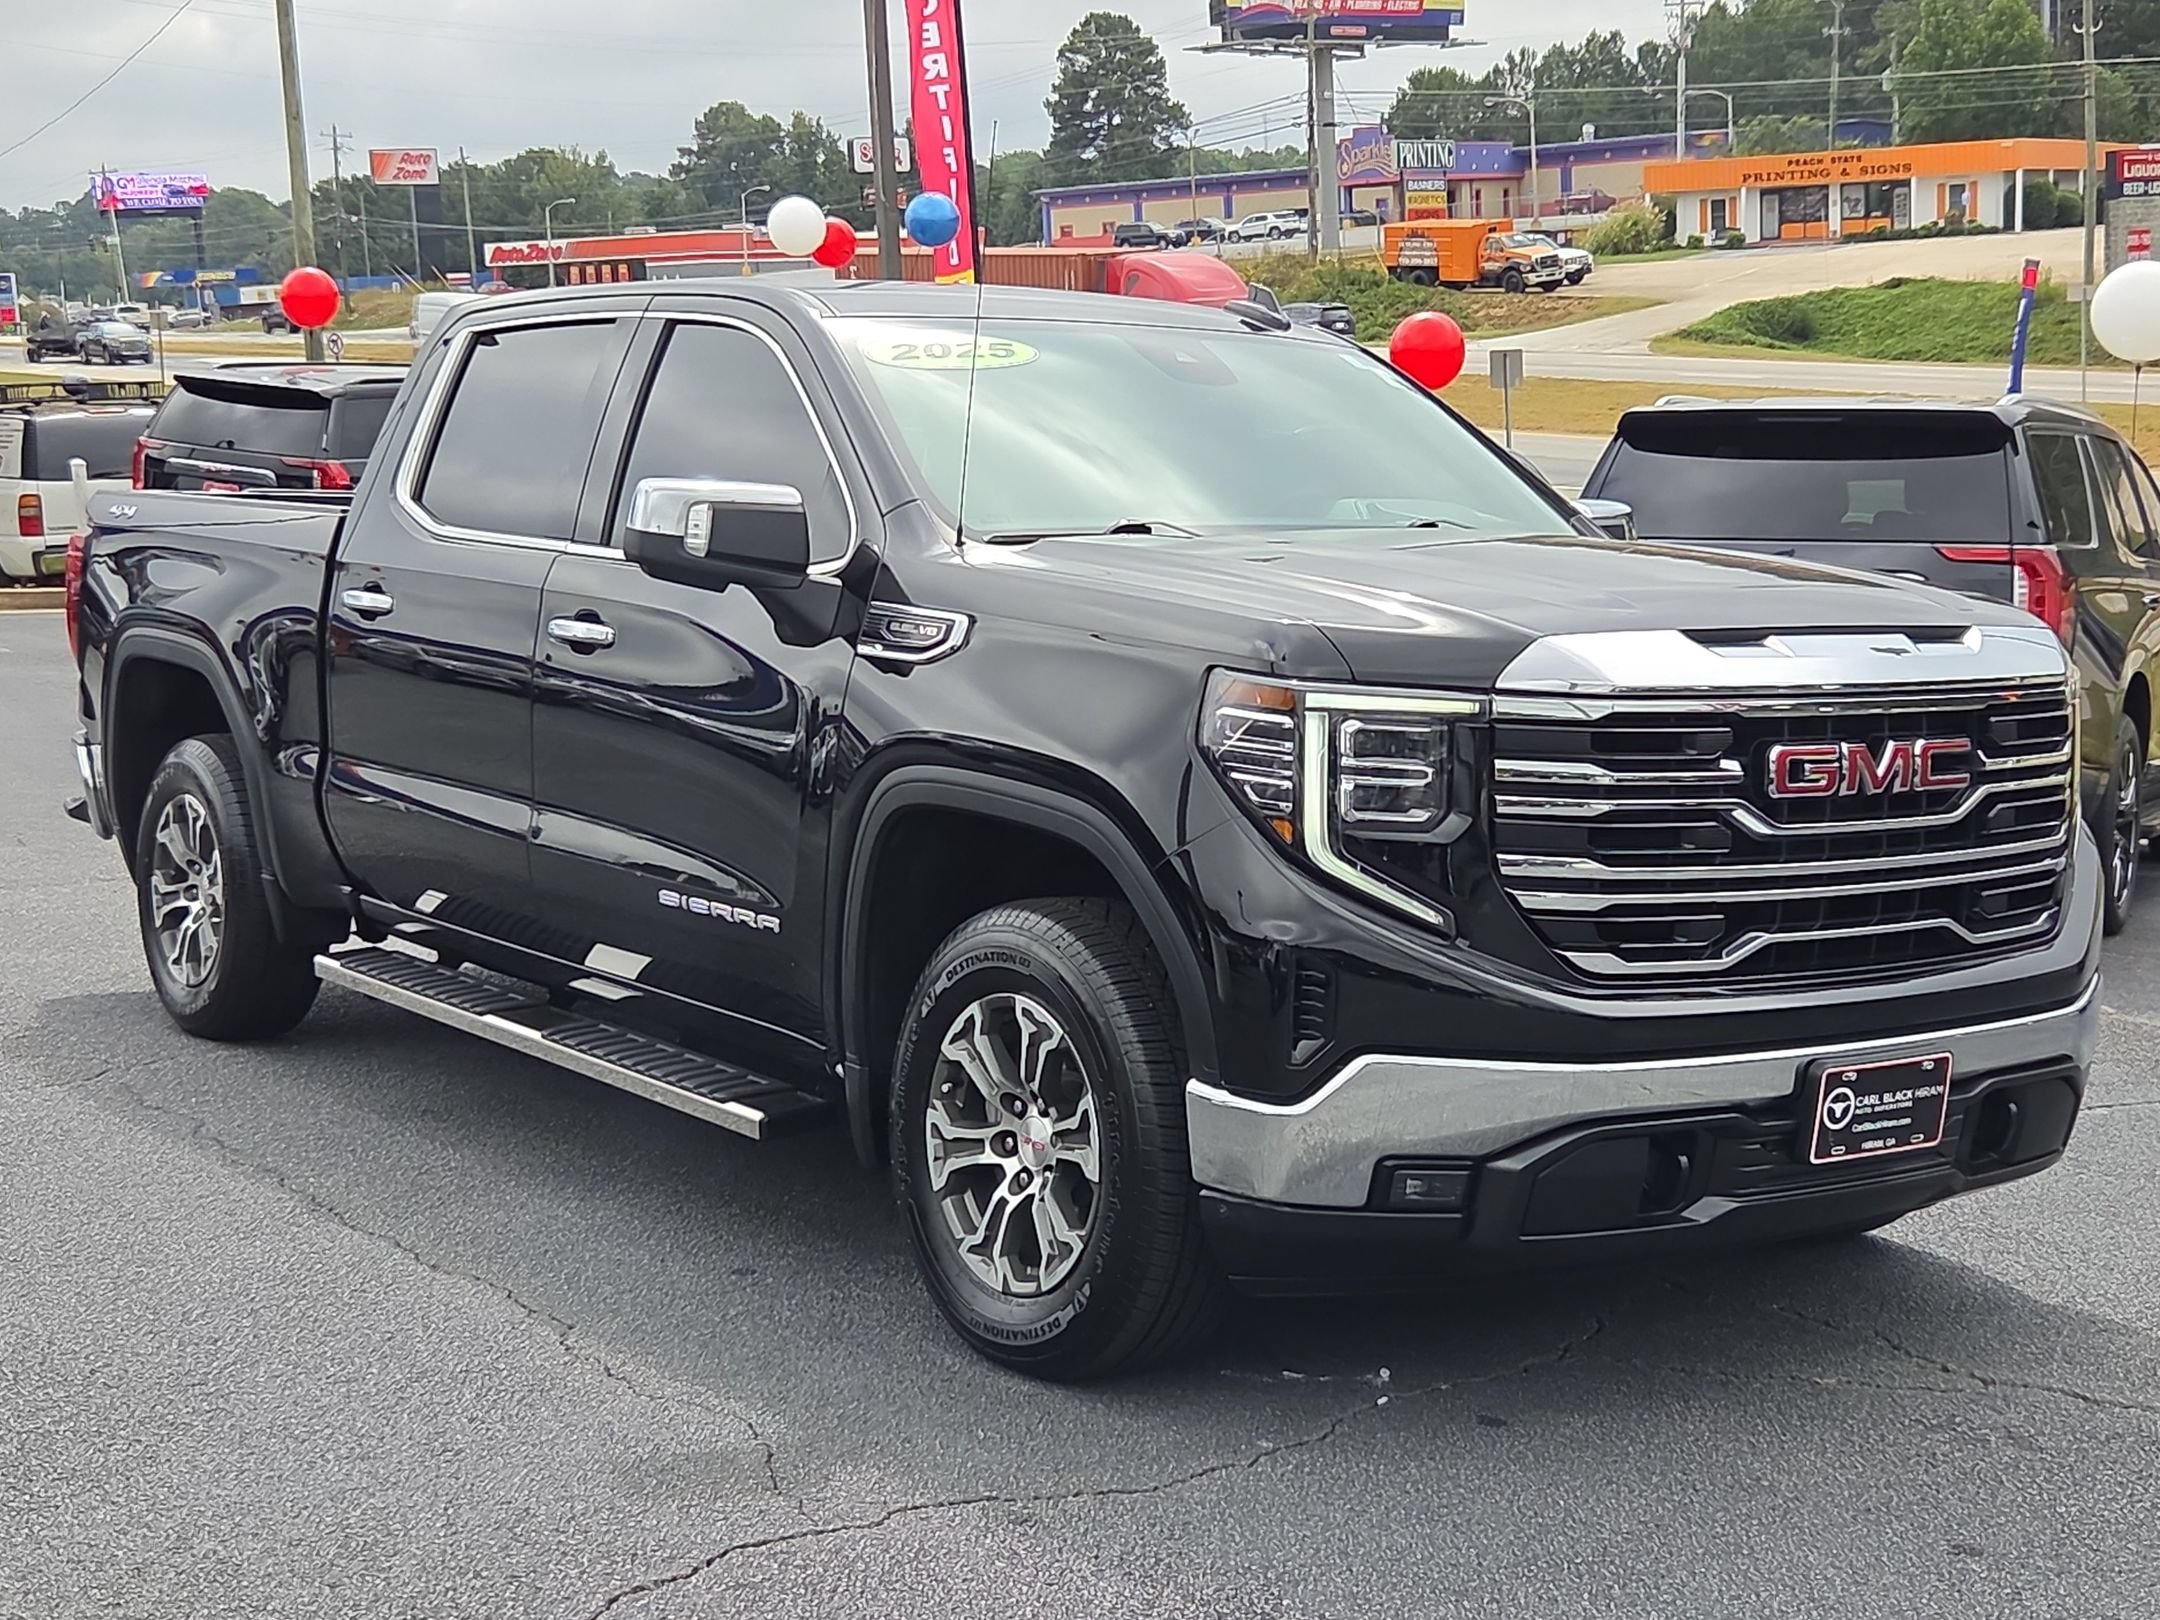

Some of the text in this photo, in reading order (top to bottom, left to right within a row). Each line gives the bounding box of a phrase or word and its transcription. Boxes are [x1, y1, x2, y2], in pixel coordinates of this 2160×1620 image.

[399, 152, 432, 165] Auto
[1337, 140, 1393, 179] Sparkle
[1400, 143, 1454, 168] PRINTING
[1787, 155, 1863, 167] PEACH STATE
[392, 167, 427, 180] Zone
[1742, 163, 1912, 183] PRINTING & SIGNS
[891, 343, 1016, 361] 2025
[1769, 738, 1971, 799] GMC
[658, 888, 780, 934] SIERRA
[944, 951, 1017, 982] DESTINATION
[1855, 1085, 1944, 1107] CARL BLACK HIRAM
[982, 1316, 1062, 1341] DESTINATION
